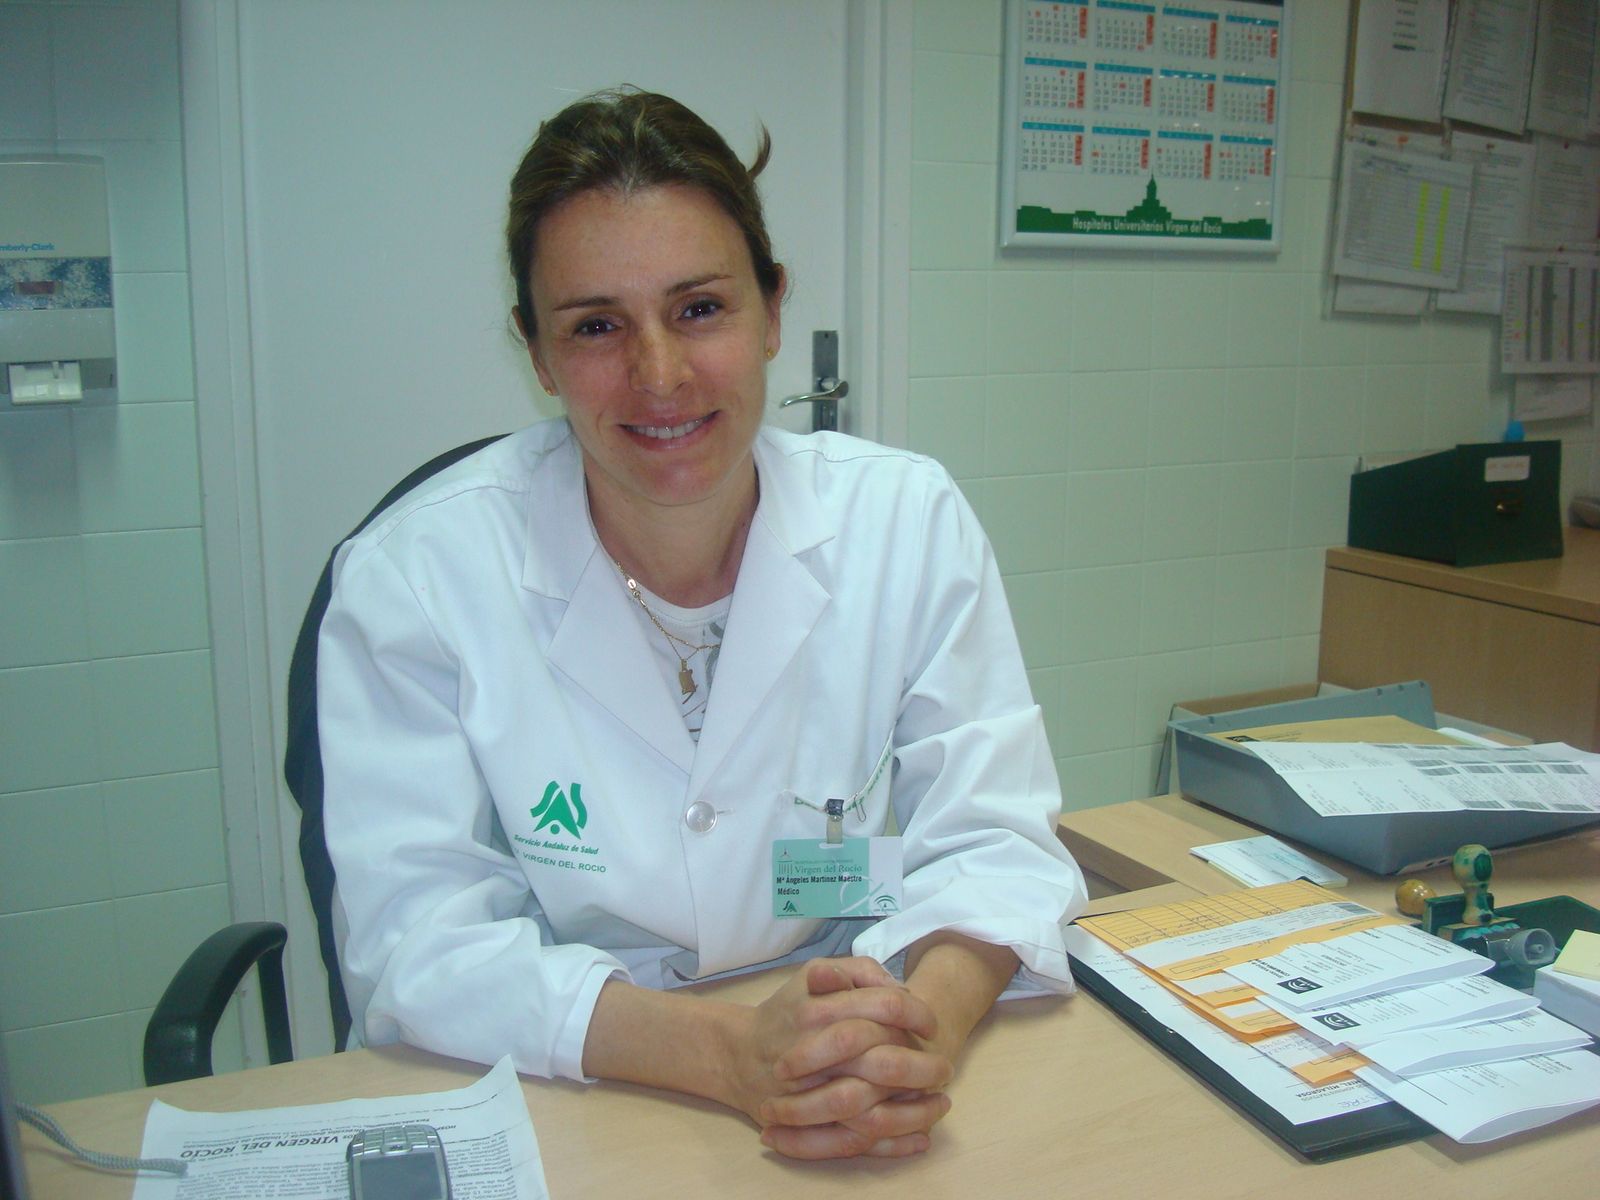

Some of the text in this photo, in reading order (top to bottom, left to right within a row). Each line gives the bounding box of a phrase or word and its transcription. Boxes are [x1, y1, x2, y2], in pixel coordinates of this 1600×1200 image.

[1072, 215, 1112, 232] Hospitales
[1114, 217, 1164, 233] Universitarios
[1166, 219, 1188, 235] Virgen
[1190, 220, 1202, 233] del
[513, 834, 600, 855] Servicio Andaluz de Salud
[522, 851, 557, 866] VIRGEN
[558, 859, 576, 870] DEL
[578, 862, 607, 873] ROCIO
[795, 866, 821, 875] Virgen
[824, 864, 836, 874] del
[838, 874, 862, 883] Maestro
[777, 887, 800, 896] Médico
[240, 1140, 271, 1152] DEL
[275, 1136, 338, 1149] VIRGEN
